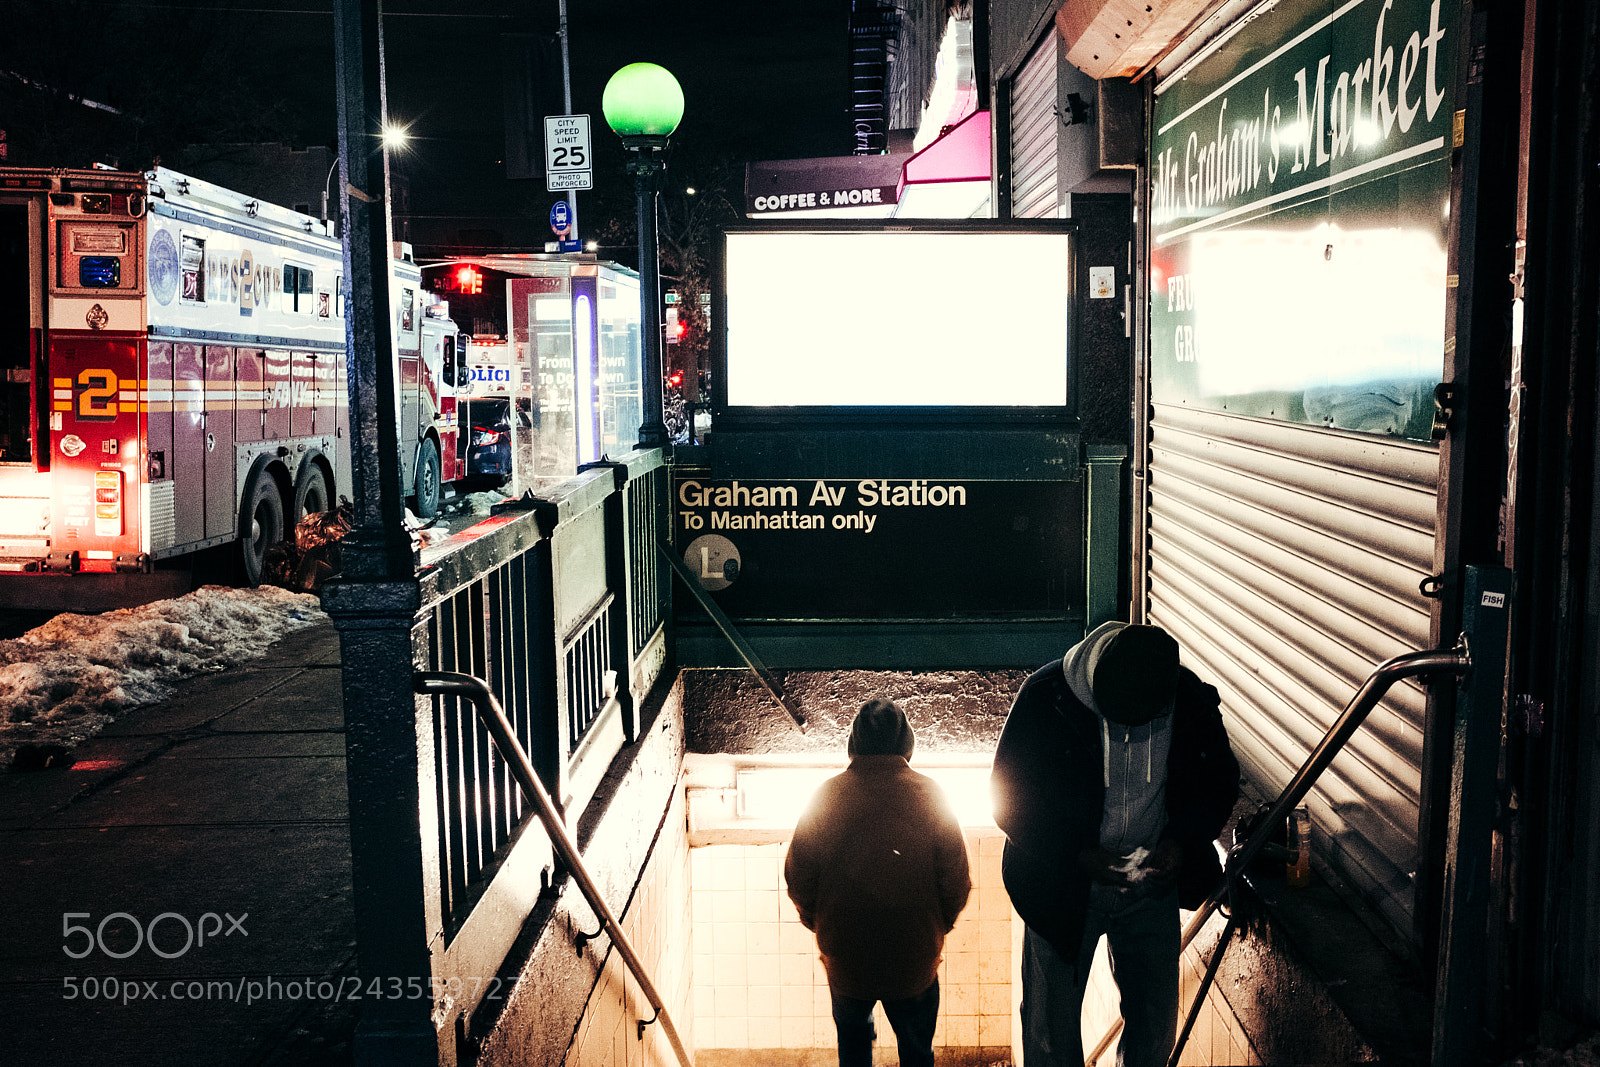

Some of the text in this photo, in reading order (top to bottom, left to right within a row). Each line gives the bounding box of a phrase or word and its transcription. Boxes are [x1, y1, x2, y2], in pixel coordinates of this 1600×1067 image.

[1158, 0, 1447, 222] Mr. Graham's Market
[554, 128, 580, 136] SPEED
[552, 146, 586, 167] 25
[754, 188, 883, 211] COFFEE & MORE
[1167, 274, 1195, 313] FRU
[538, 356, 571, 368] From
[469, 369, 510, 381] OLIC
[538, 372, 554, 385] To
[75, 368, 118, 423] 2
[678, 479, 968, 507] Graham Av Station
[679, 510, 877, 533] To Manhattan only
[701, 547, 724, 579] L
[1483, 595, 1503, 605] FISH
